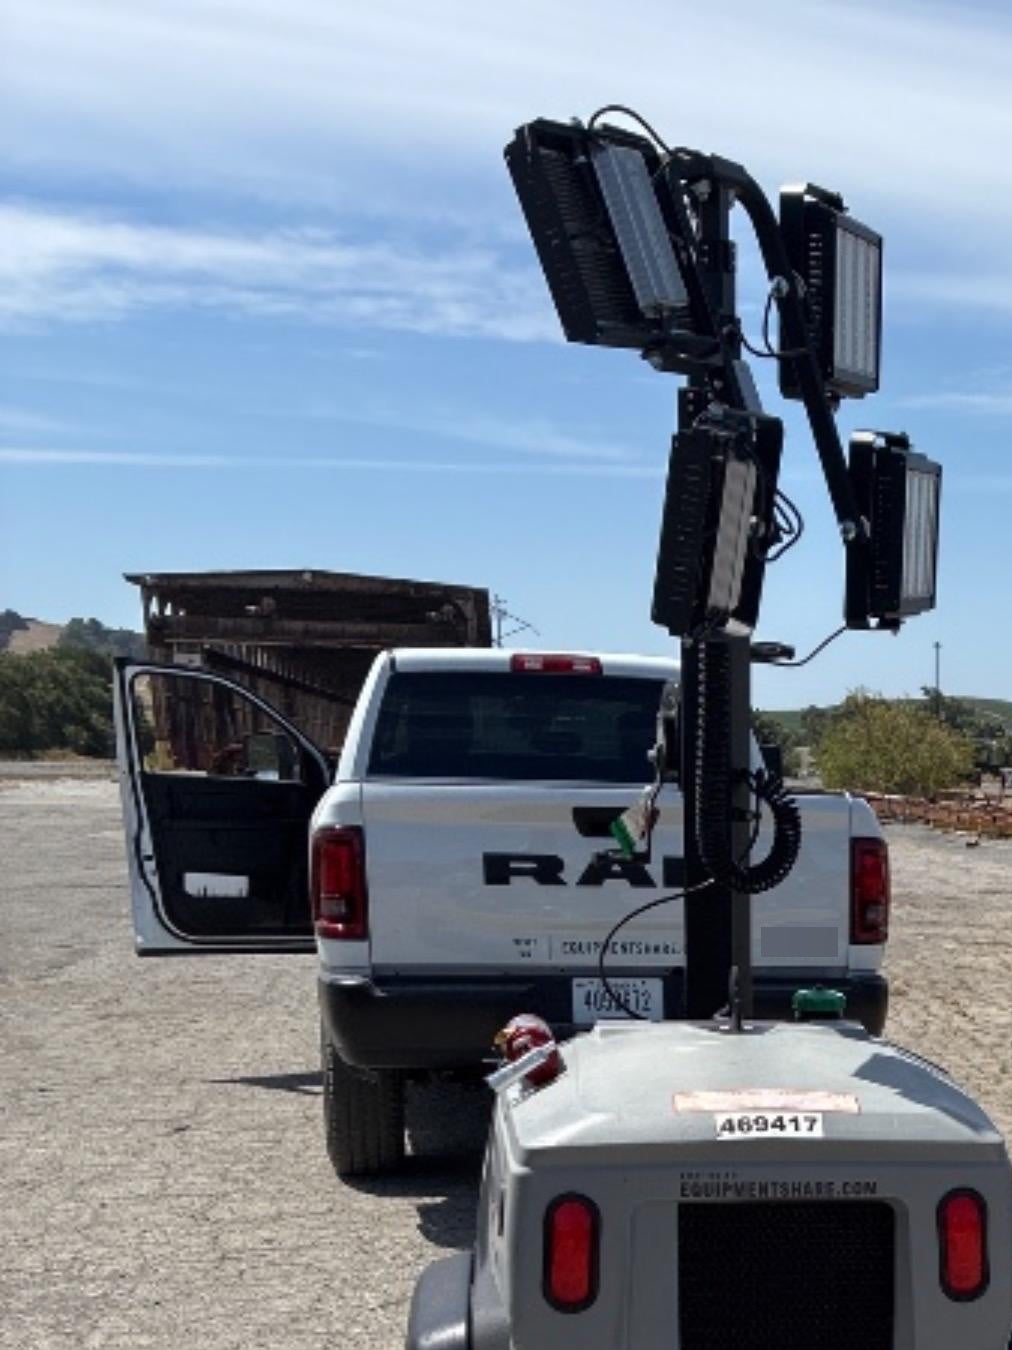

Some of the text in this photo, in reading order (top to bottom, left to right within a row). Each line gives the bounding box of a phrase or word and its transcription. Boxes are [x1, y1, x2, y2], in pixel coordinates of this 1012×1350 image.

[483, 852, 685, 888] RA
[719, 1115, 818, 1134] 469417
[679, 1181, 878, 1199] EQUIPMENTSHARE.COM
